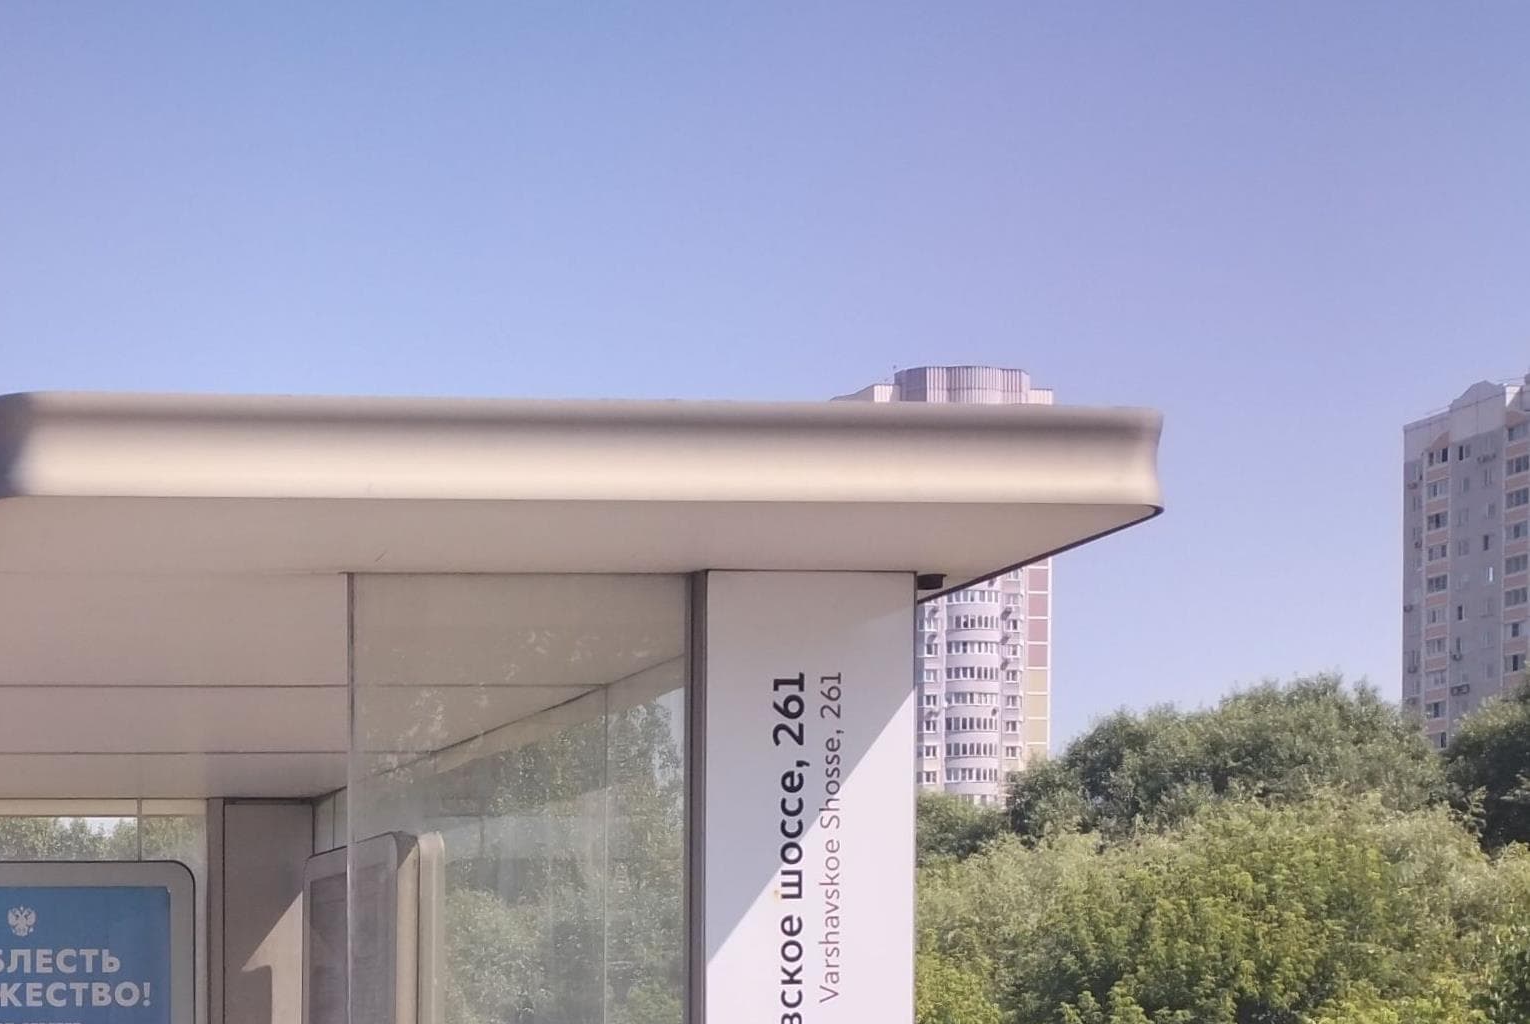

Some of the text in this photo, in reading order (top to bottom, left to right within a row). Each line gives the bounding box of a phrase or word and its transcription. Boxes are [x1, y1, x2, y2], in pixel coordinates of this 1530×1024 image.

[773, 672, 805, 747] 261
[780, 757, 810, 899] шоссе,
[819, 672, 844, 1003] Varshavskoe Shosse, 261
